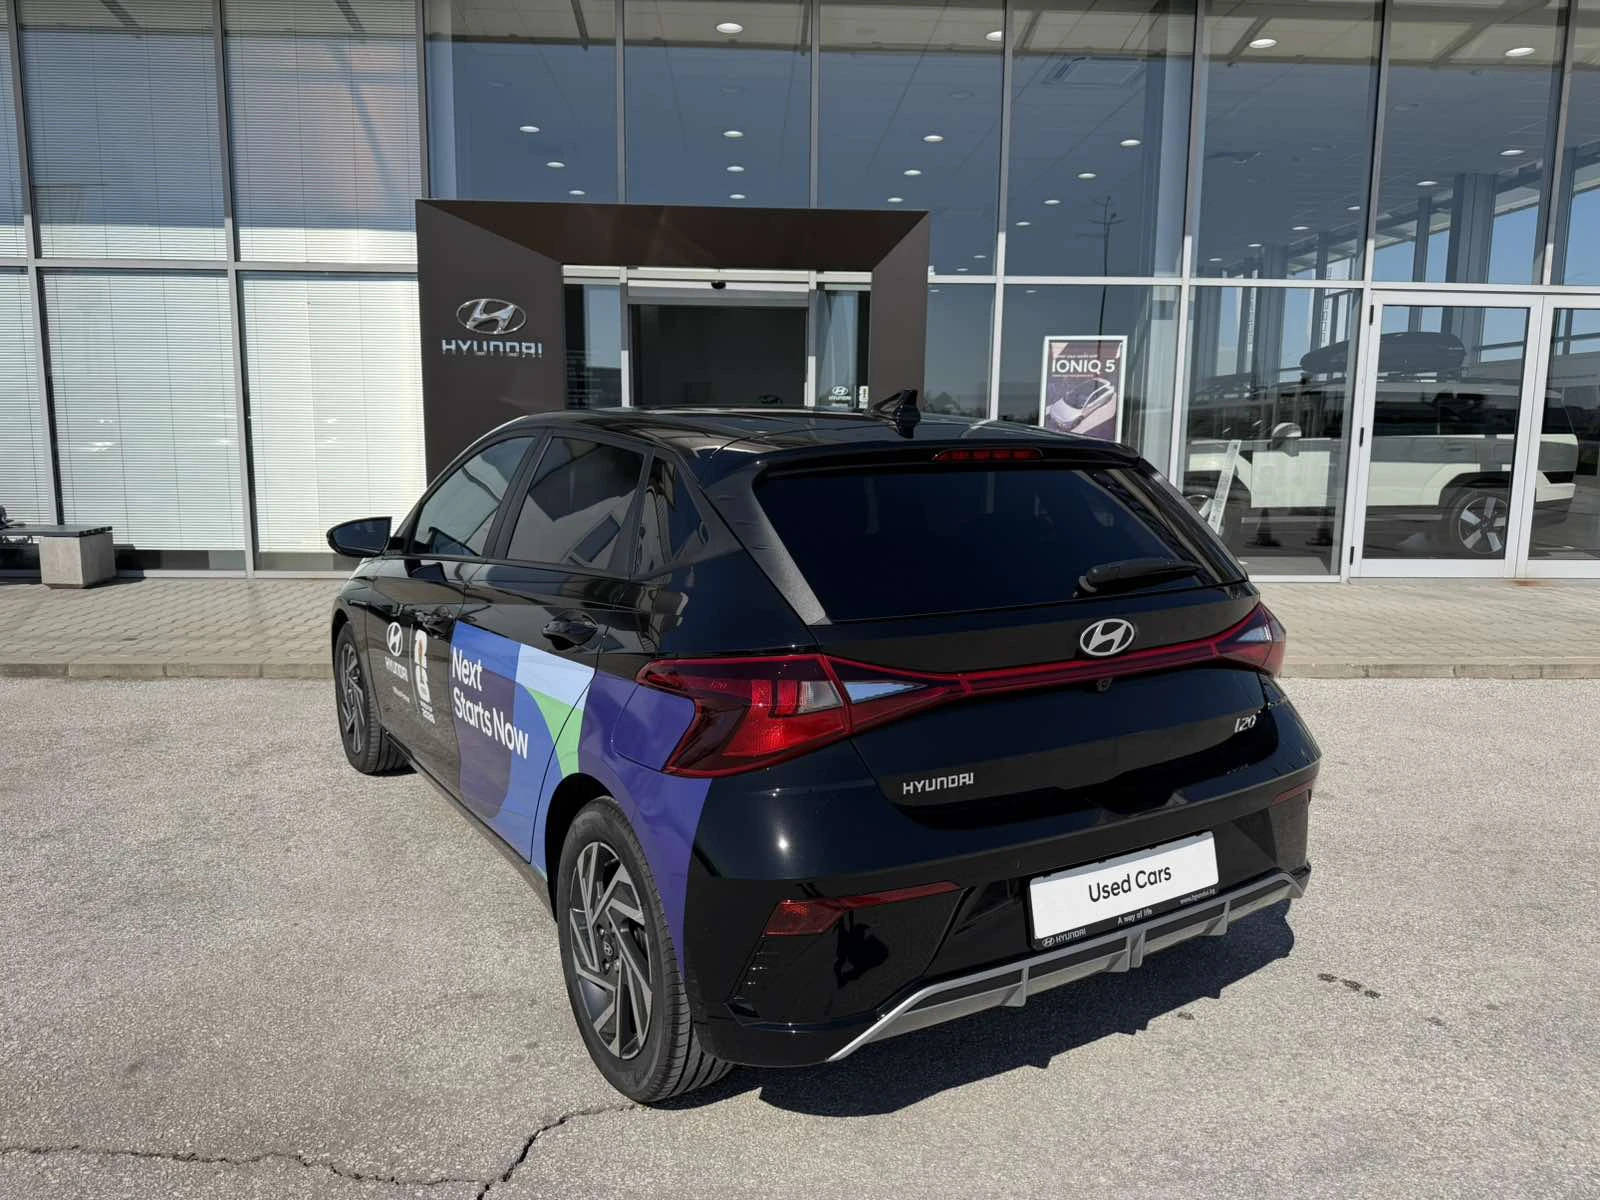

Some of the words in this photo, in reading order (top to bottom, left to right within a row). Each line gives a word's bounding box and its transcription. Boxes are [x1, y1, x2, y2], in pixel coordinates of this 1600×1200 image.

[441, 339, 544, 358] HYUNDAI
[1052, 359, 1101, 375] IONIQ
[1104, 359, 1116, 373] 5
[452, 646, 483, 692] Next
[453, 686, 493, 737] Starts
[492, 707, 529, 760] Now
[902, 772, 974, 795] HYUNDAI
[1088, 873, 1132, 903] Used
[1135, 866, 1172, 889] Cars
[1117, 916, 1124, 927] A
[1055, 927, 1087, 944] HYUNDAI
